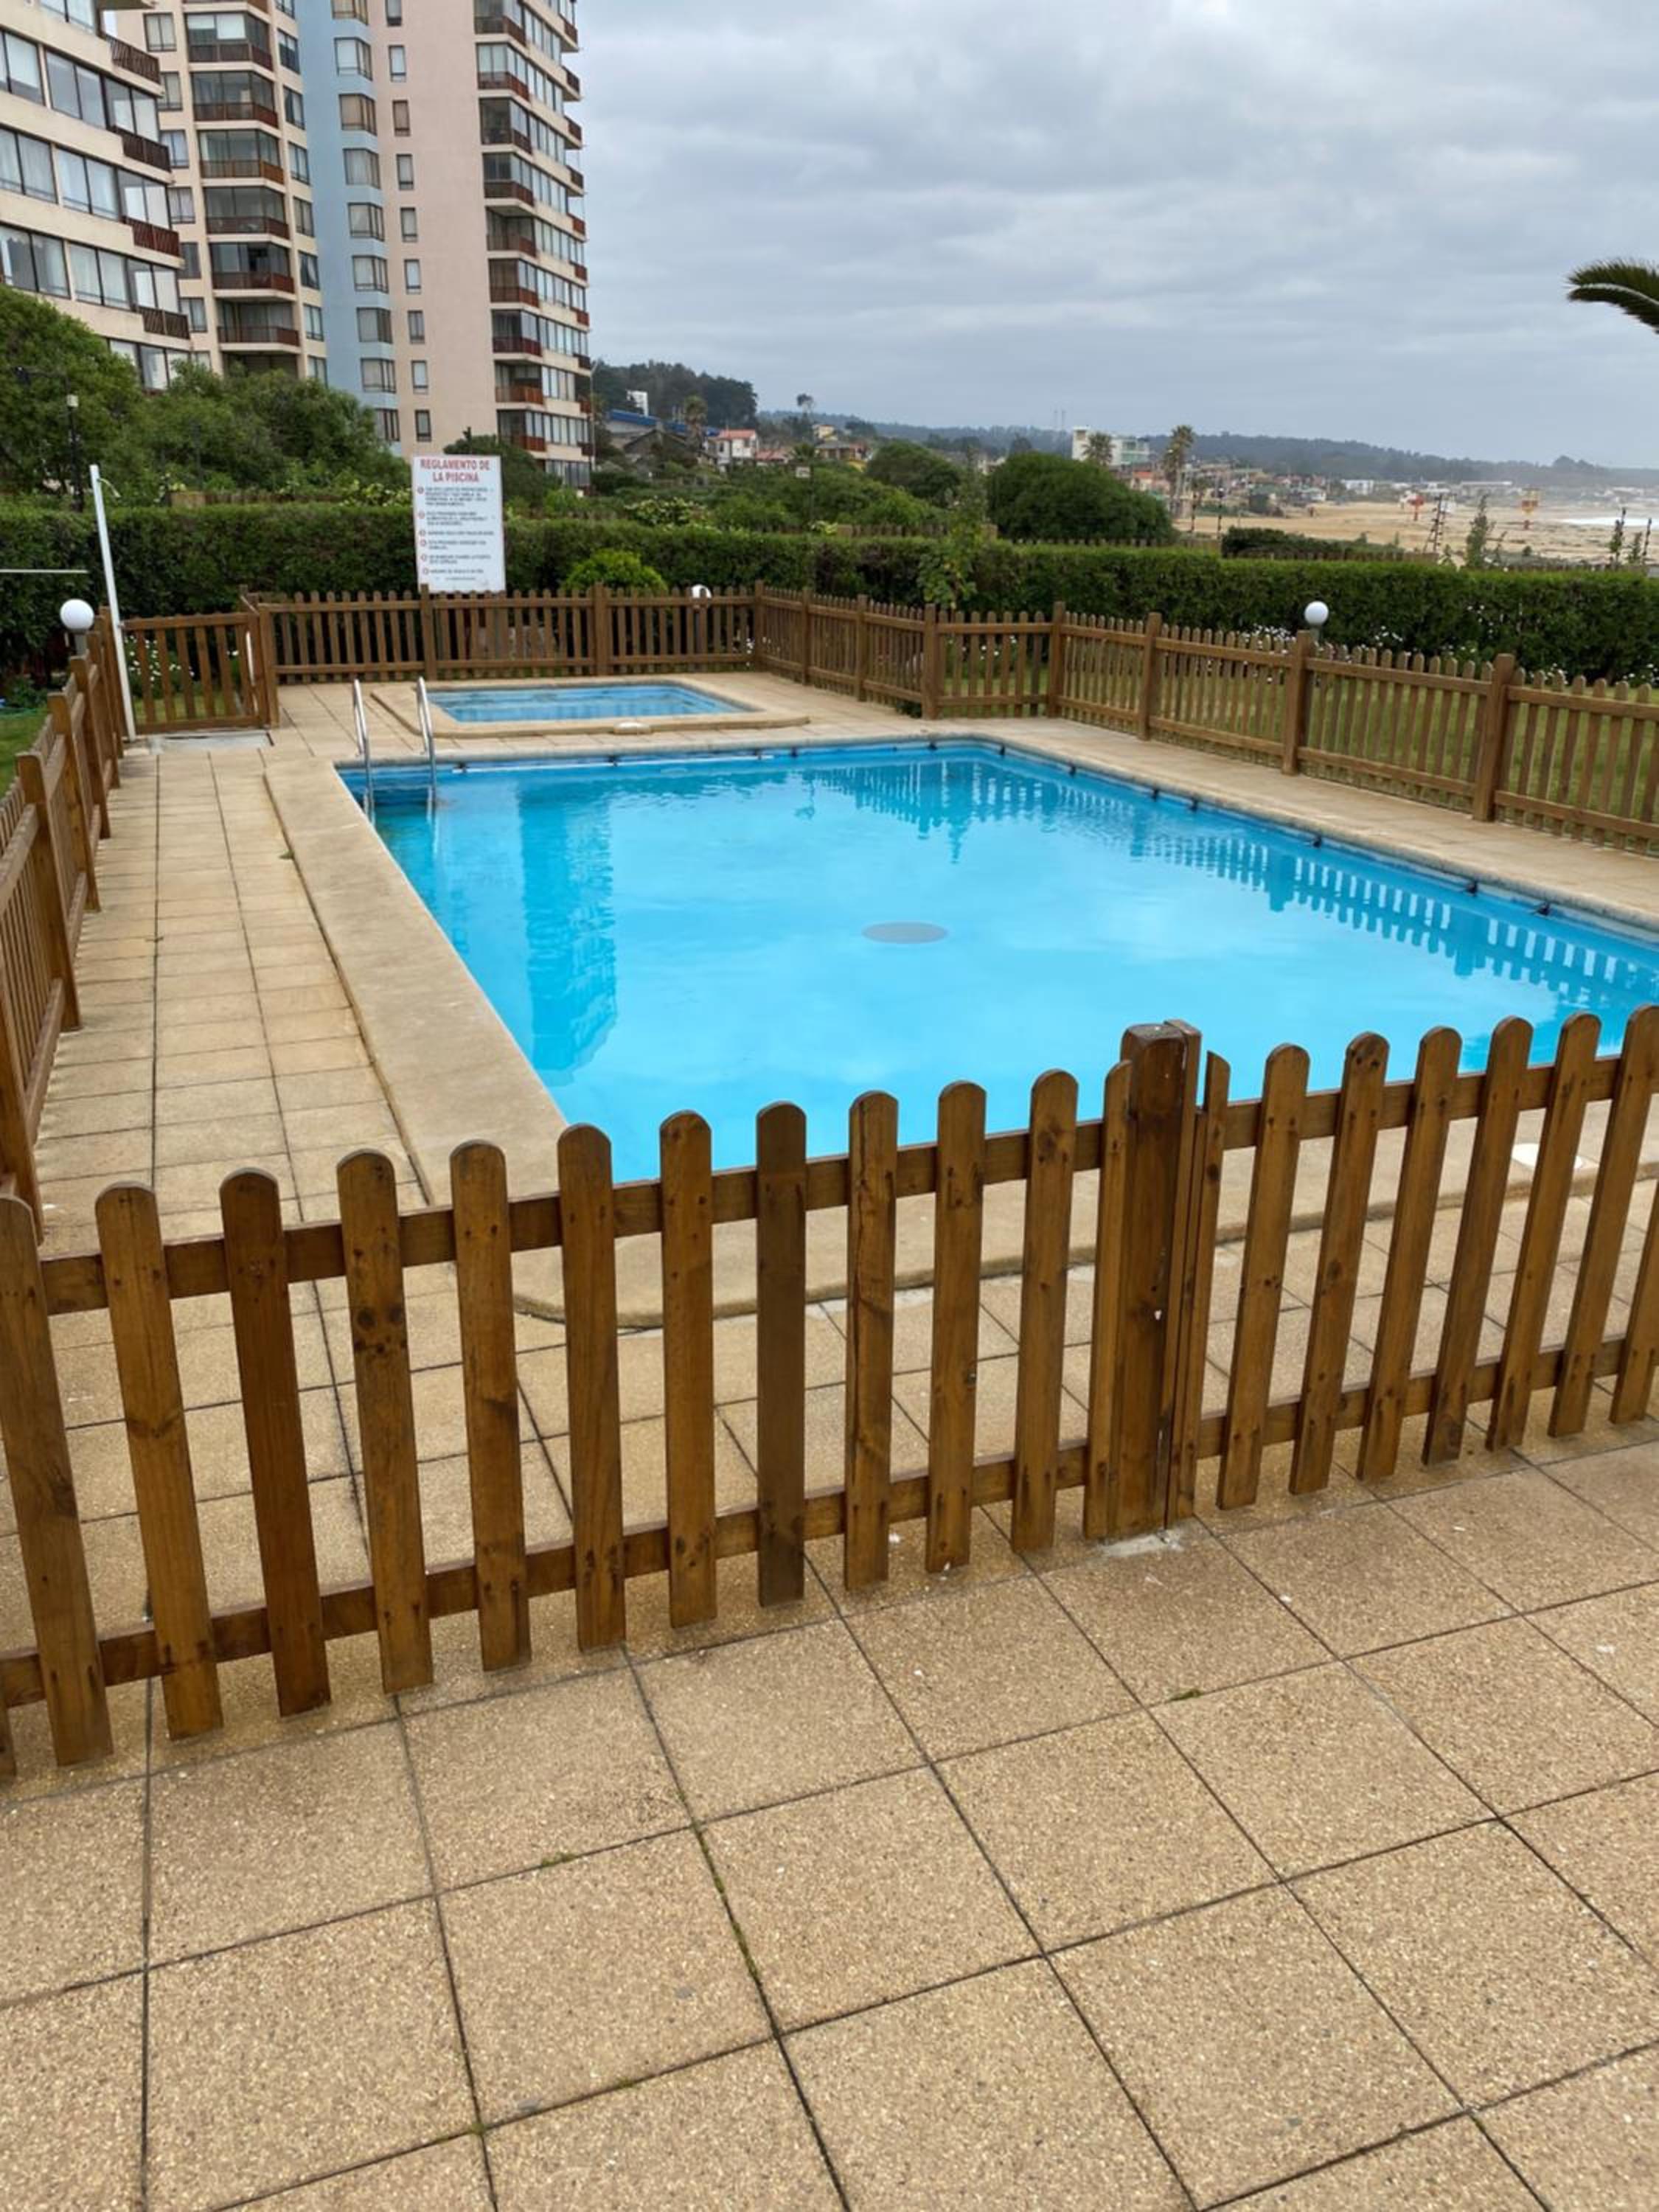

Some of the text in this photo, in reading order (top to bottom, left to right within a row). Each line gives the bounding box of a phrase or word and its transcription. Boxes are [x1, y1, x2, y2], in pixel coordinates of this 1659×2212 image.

[420, 459, 490, 470] REGLAMENTO DE
[433, 472, 479, 482] LA PISCINA
